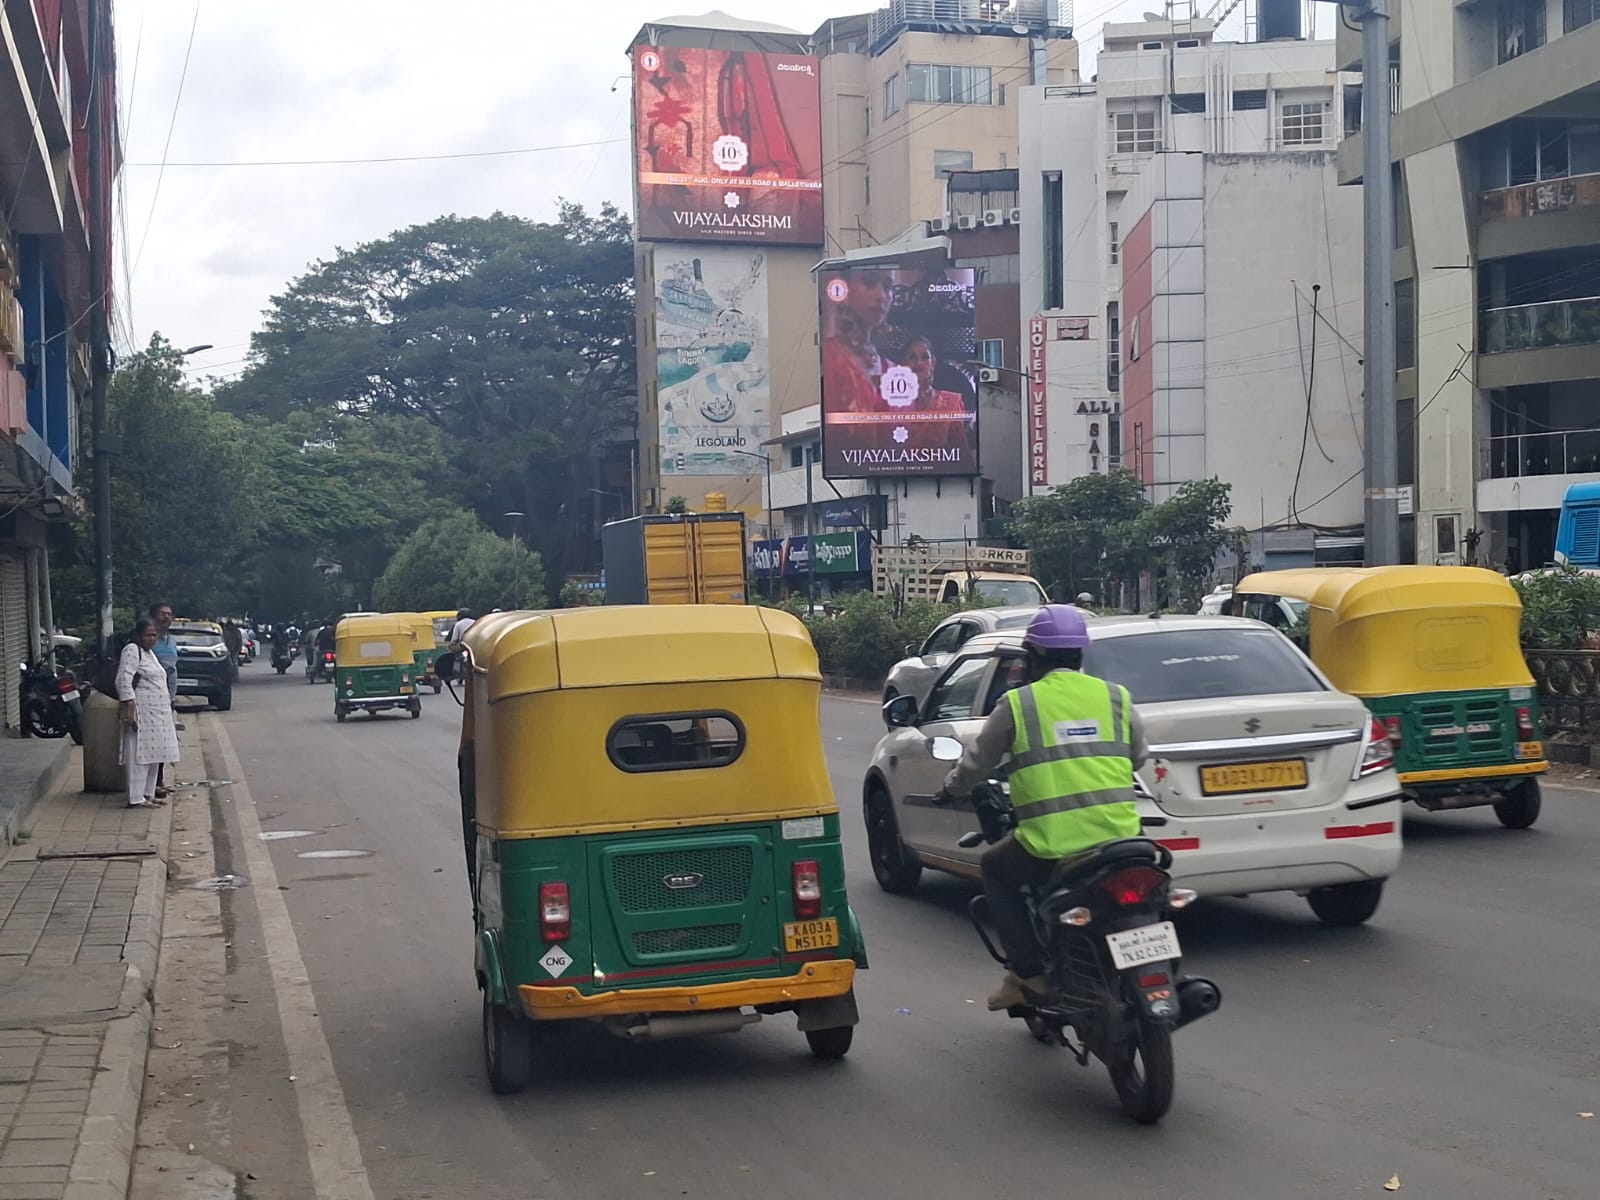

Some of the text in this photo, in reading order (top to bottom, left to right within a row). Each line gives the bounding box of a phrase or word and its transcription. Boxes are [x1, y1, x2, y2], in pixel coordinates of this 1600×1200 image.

[673, 211, 792, 229] VIJAYALAKSHMI
[1032, 321, 1044, 482] HOTEL VELLARA
[1076, 400, 1112, 414] ALL
[696, 437, 747, 447] LEGOLAND
[1089, 422, 1101, 474] SAI
[842, 448, 961, 466] VIJAYALAKSHMI
[988, 549, 1014, 561] RKR
[794, 921, 832, 936] KA03A
[795, 934, 833, 949] M5112
[546, 956, 566, 966] CNG
